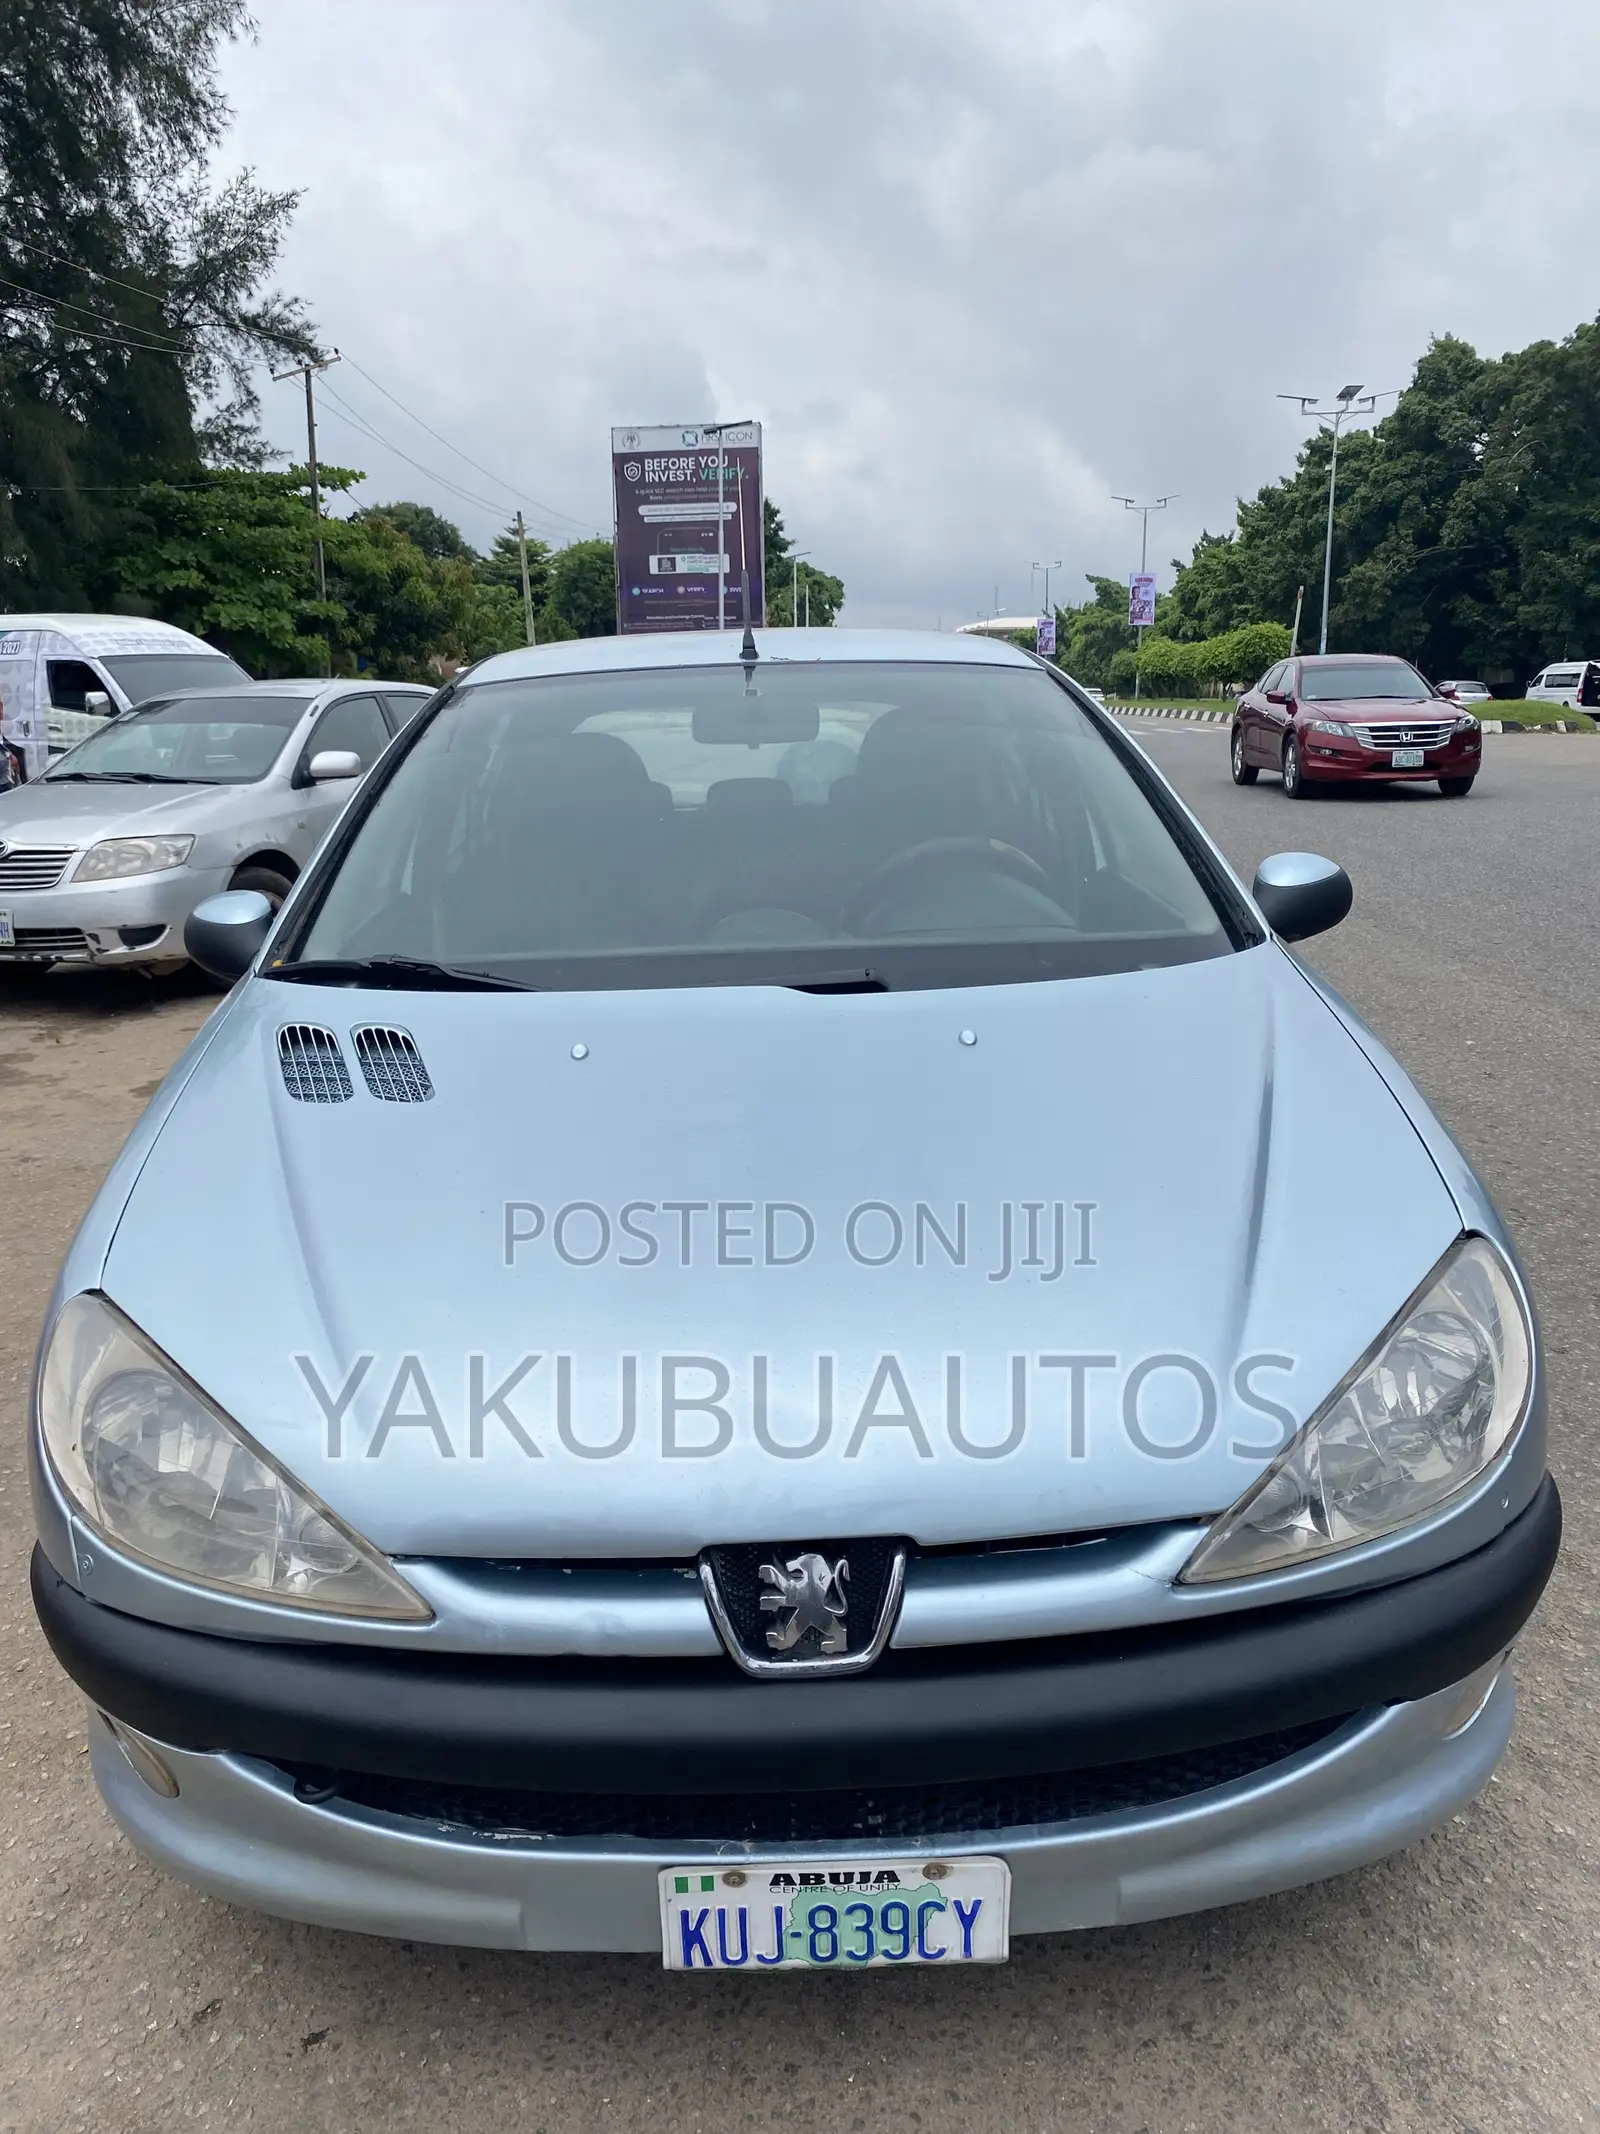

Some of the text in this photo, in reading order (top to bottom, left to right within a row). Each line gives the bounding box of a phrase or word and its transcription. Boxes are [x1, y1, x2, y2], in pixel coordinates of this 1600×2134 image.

[725, 431, 753, 442] ICON
[644, 455, 728, 471] BEFORE YOU
[645, 470, 697, 483] INVEST,
[769, 1870, 901, 1887] ABUJA
[769, 1883, 901, 1894] CENTRE OF UNITY
[680, 1899, 983, 1967] KUJ-839CY
